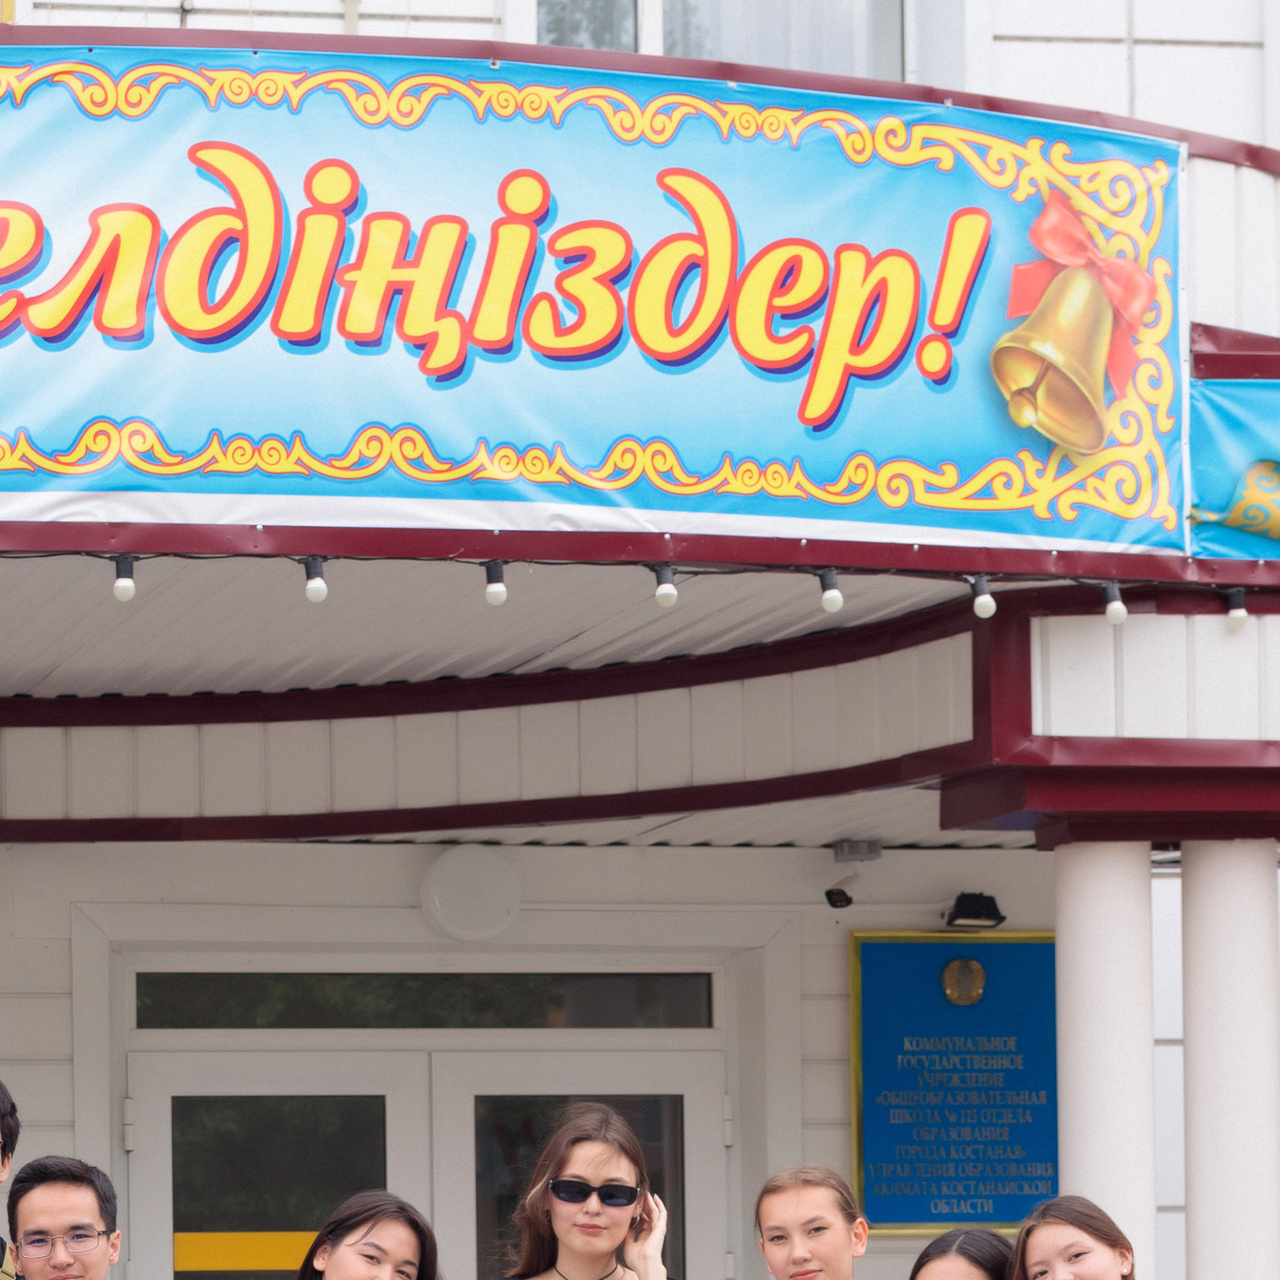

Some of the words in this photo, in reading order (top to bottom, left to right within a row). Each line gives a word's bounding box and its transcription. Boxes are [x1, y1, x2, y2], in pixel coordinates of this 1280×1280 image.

[903, 1037, 1018, 1052] КОММУНАЛЬНОЕ
[897, 1055, 1024, 1070] ГОСУДАРСТВЕННОЕ
[917, 1073, 1005, 1088] УЧРЕЖДЕНИЕ
[889, 1109, 941, 1123] ШКОЛА
[980, 1109, 1033, 1124] ОТДЕЛА
[912, 1127, 1009, 1141] ОБРАЗОВАНИЯ
[895, 1145, 947, 1160] ГОРОДА
[869, 1163, 955, 1179] УПРАВЛЕНИЯ
[958, 1163, 1055, 1178] ОБРАЗОВАНИЯ
[873, 1181, 938, 1196] АКИМАТА
[930, 1199, 993, 1214] ОБЛАСТИ
